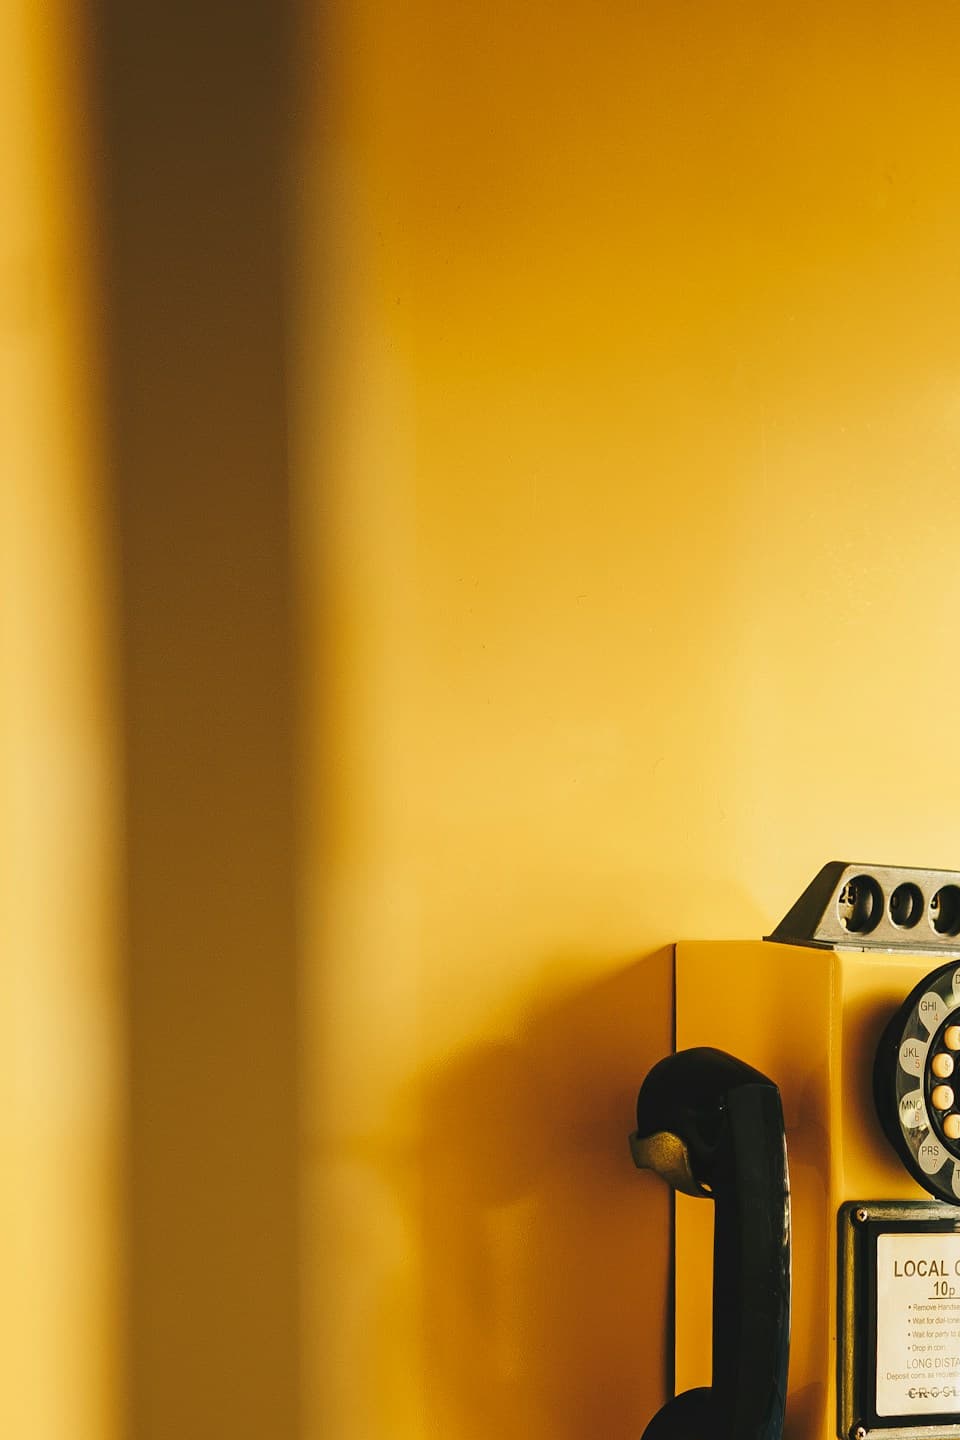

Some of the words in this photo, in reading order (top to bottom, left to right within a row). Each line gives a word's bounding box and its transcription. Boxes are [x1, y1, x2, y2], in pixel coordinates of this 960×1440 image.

[920, 1001, 937, 1011] GHI
[903, 1048, 920, 1058] JKL
[914, 1060, 921, 1069] 5
[902, 1101, 922, 1112] MNO
[914, 1113, 920, 1122] 6
[921, 1146, 939, 1156] PRS
[893, 1260, 949, 1277] LOCAL
[933, 1280, 955, 1298] 10p
[912, 1303, 937, 1312] Remove
[912, 1317, 926, 1325] Wait
[926, 1317, 935, 1325] for
[912, 1330, 926, 1338] Wait
[926, 1330, 934, 1338] for
[911, 1344, 927, 1353] Drop
[906, 1358, 933, 1370] LONG
[886, 1372, 911, 1381] Deposit
